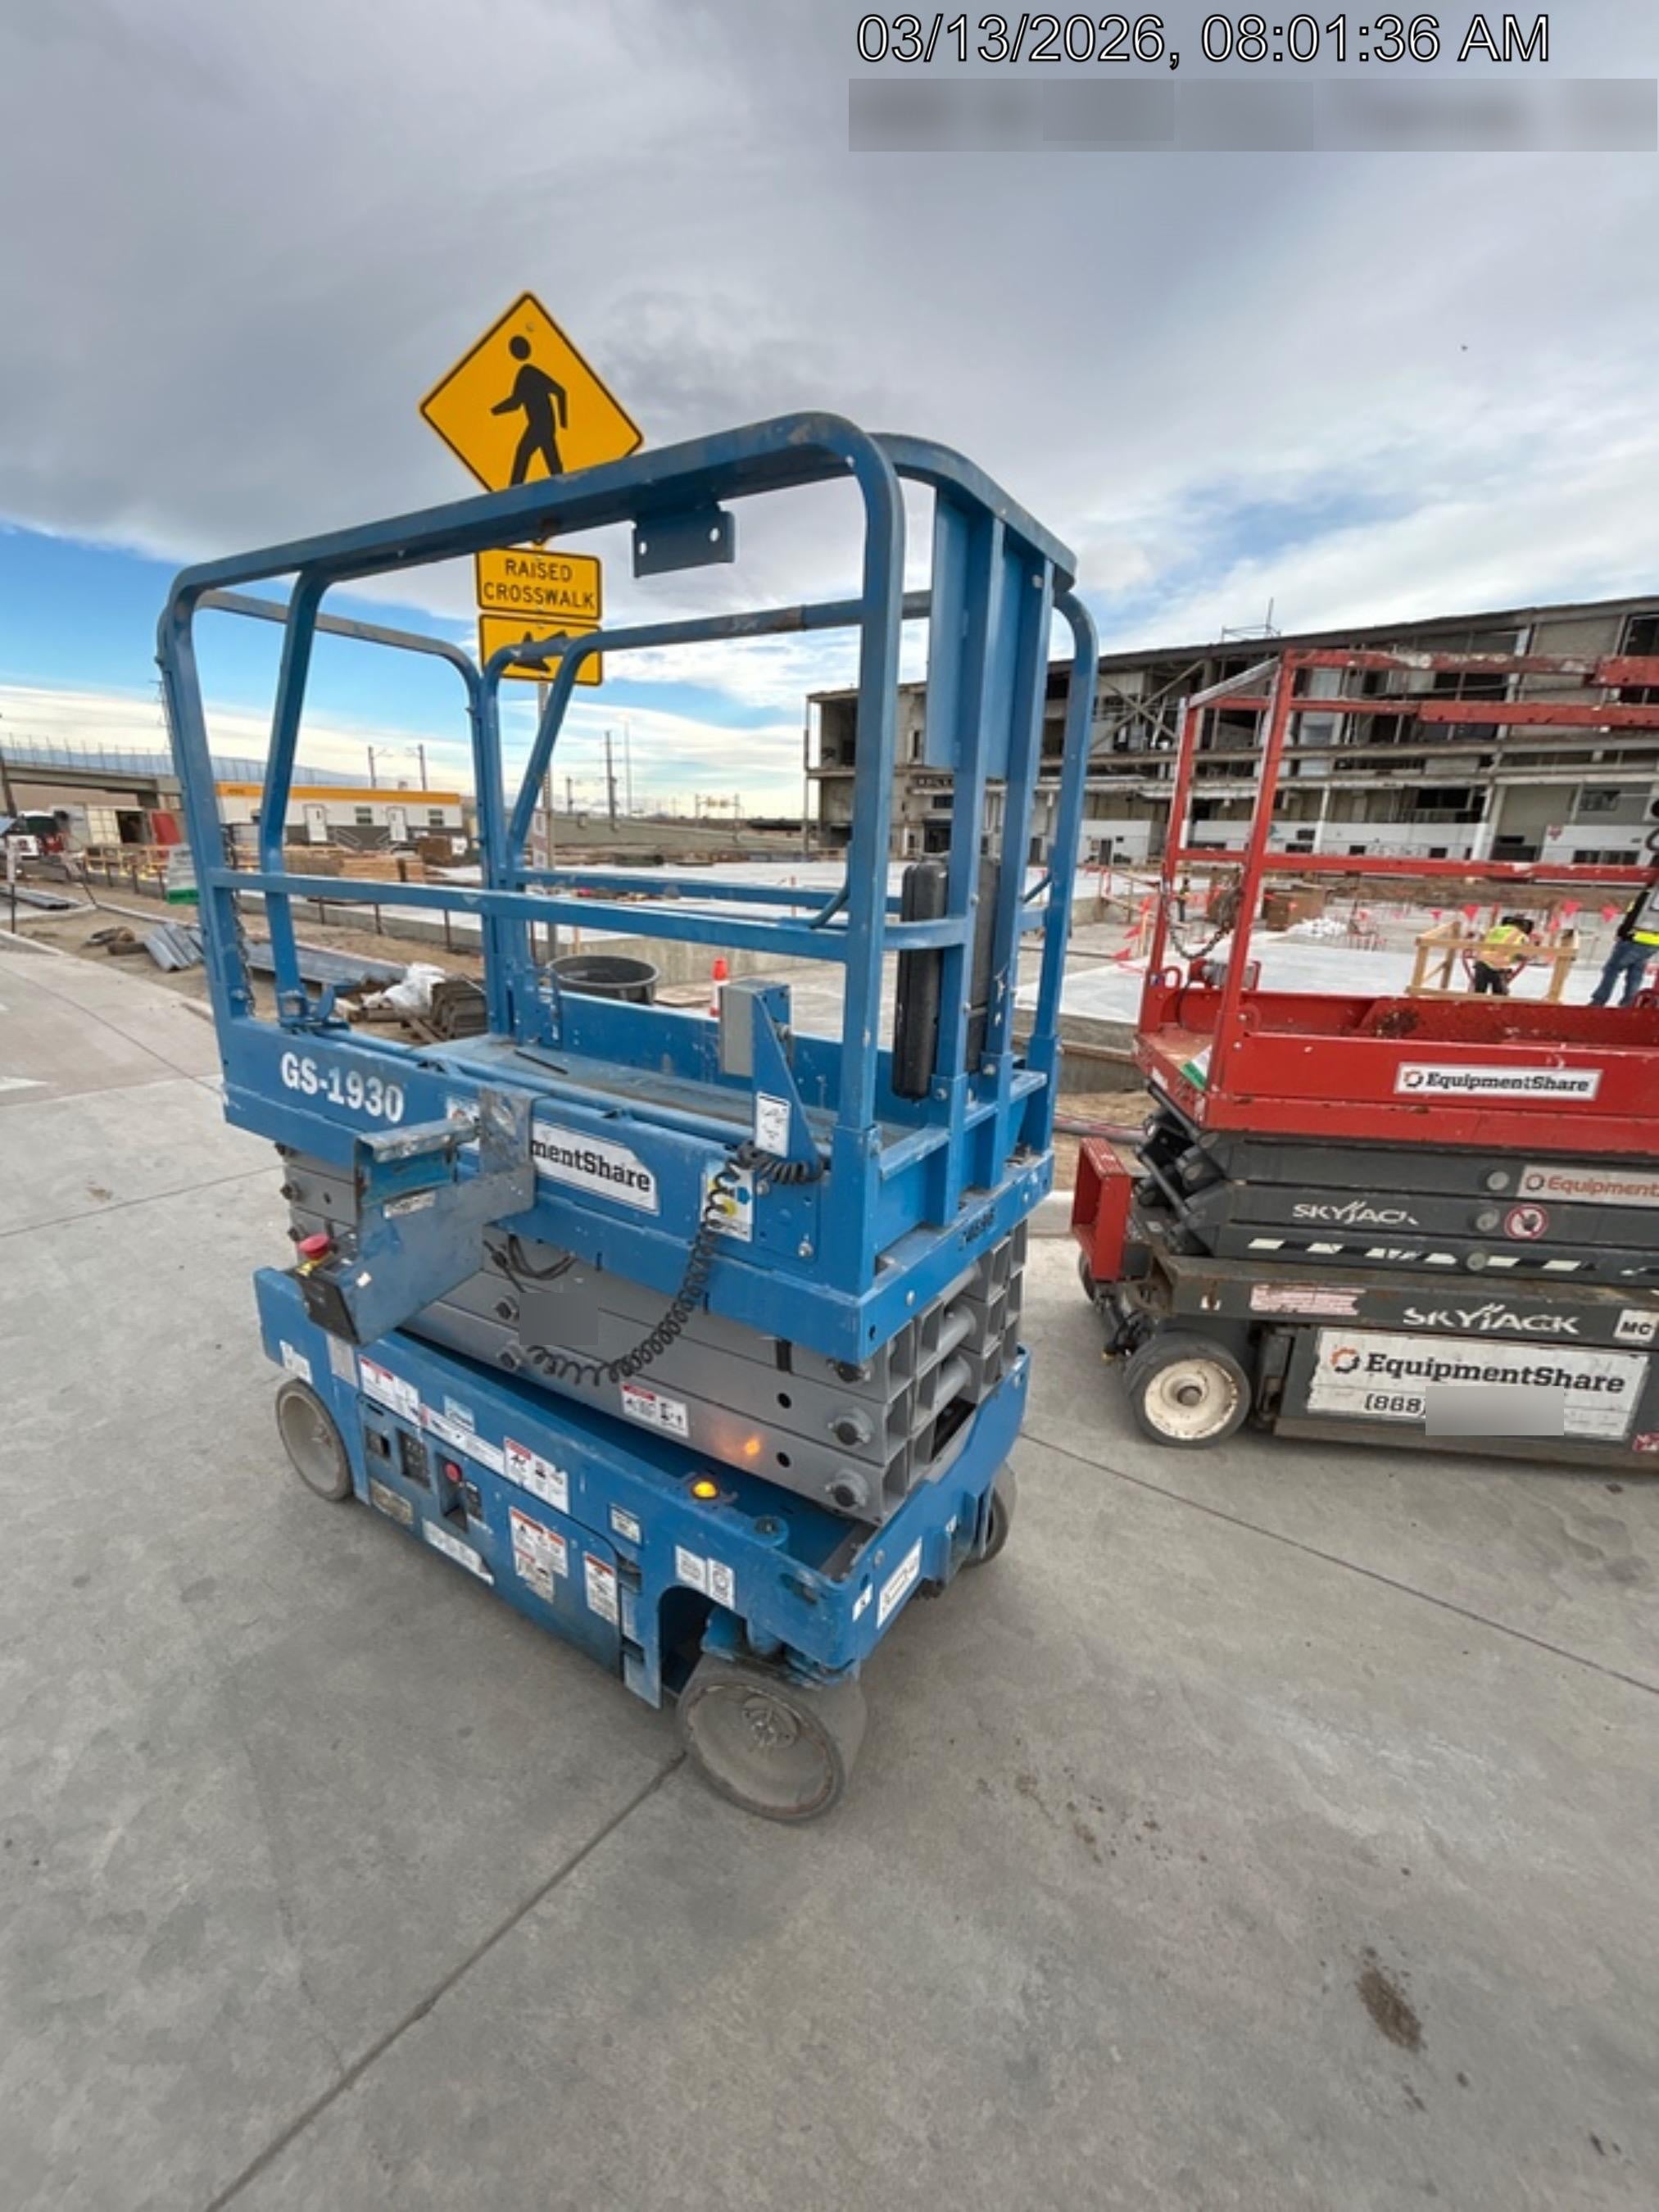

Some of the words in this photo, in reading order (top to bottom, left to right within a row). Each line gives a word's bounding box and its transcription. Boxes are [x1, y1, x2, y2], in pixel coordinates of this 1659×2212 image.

[505, 558, 573, 583] RAISED
[483, 581, 595, 610] CROSSWALK
[280, 1050, 405, 1123] GS-1930
[1426, 1071, 1589, 1093] EquipmentShare
[1403, 1302, 1580, 1335] SKYJACK
[1364, 1353, 1626, 1394] EquipmentShare
